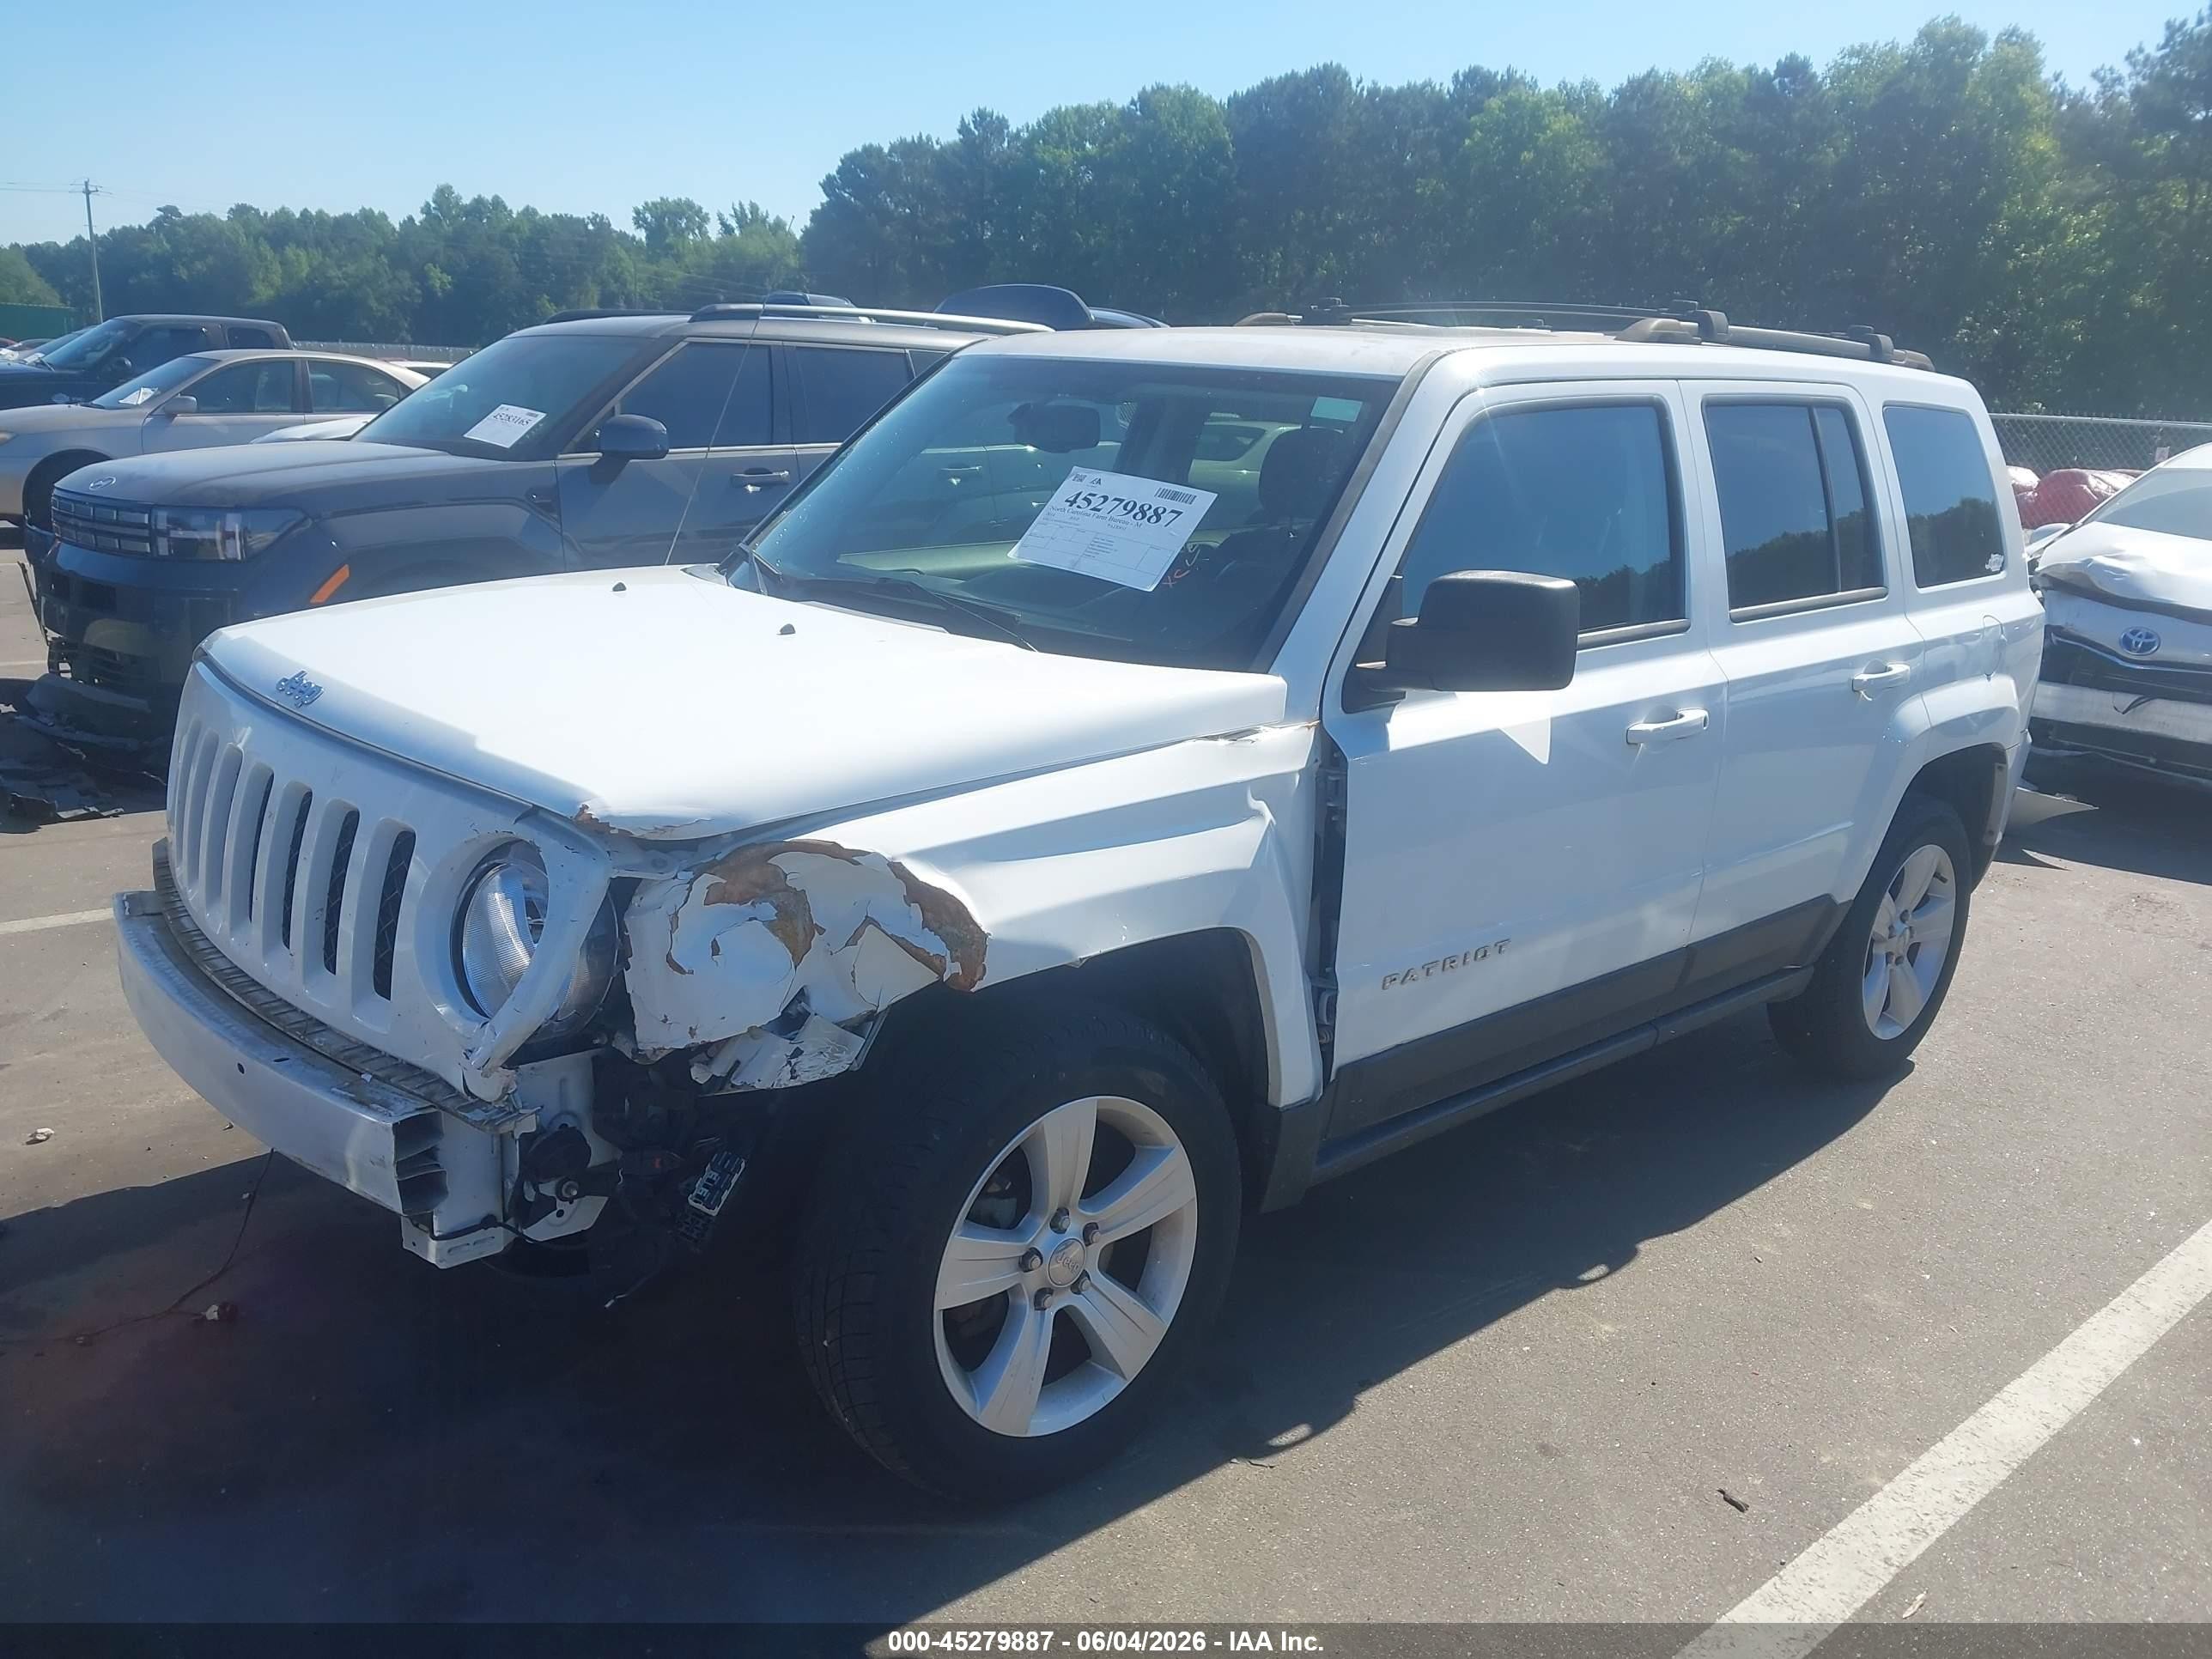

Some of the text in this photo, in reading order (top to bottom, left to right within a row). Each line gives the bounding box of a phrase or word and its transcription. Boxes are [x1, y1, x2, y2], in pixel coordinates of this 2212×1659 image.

[1049, 506, 1066, 514] North
[1067, 507, 1091, 517] Carolina
[1064, 490, 1183, 527] 45279887
[276, 670, 324, 708] Jeep
[1382, 939, 1511, 990] PATRIOT
[1056, 1252, 1080, 1273] Jeep
